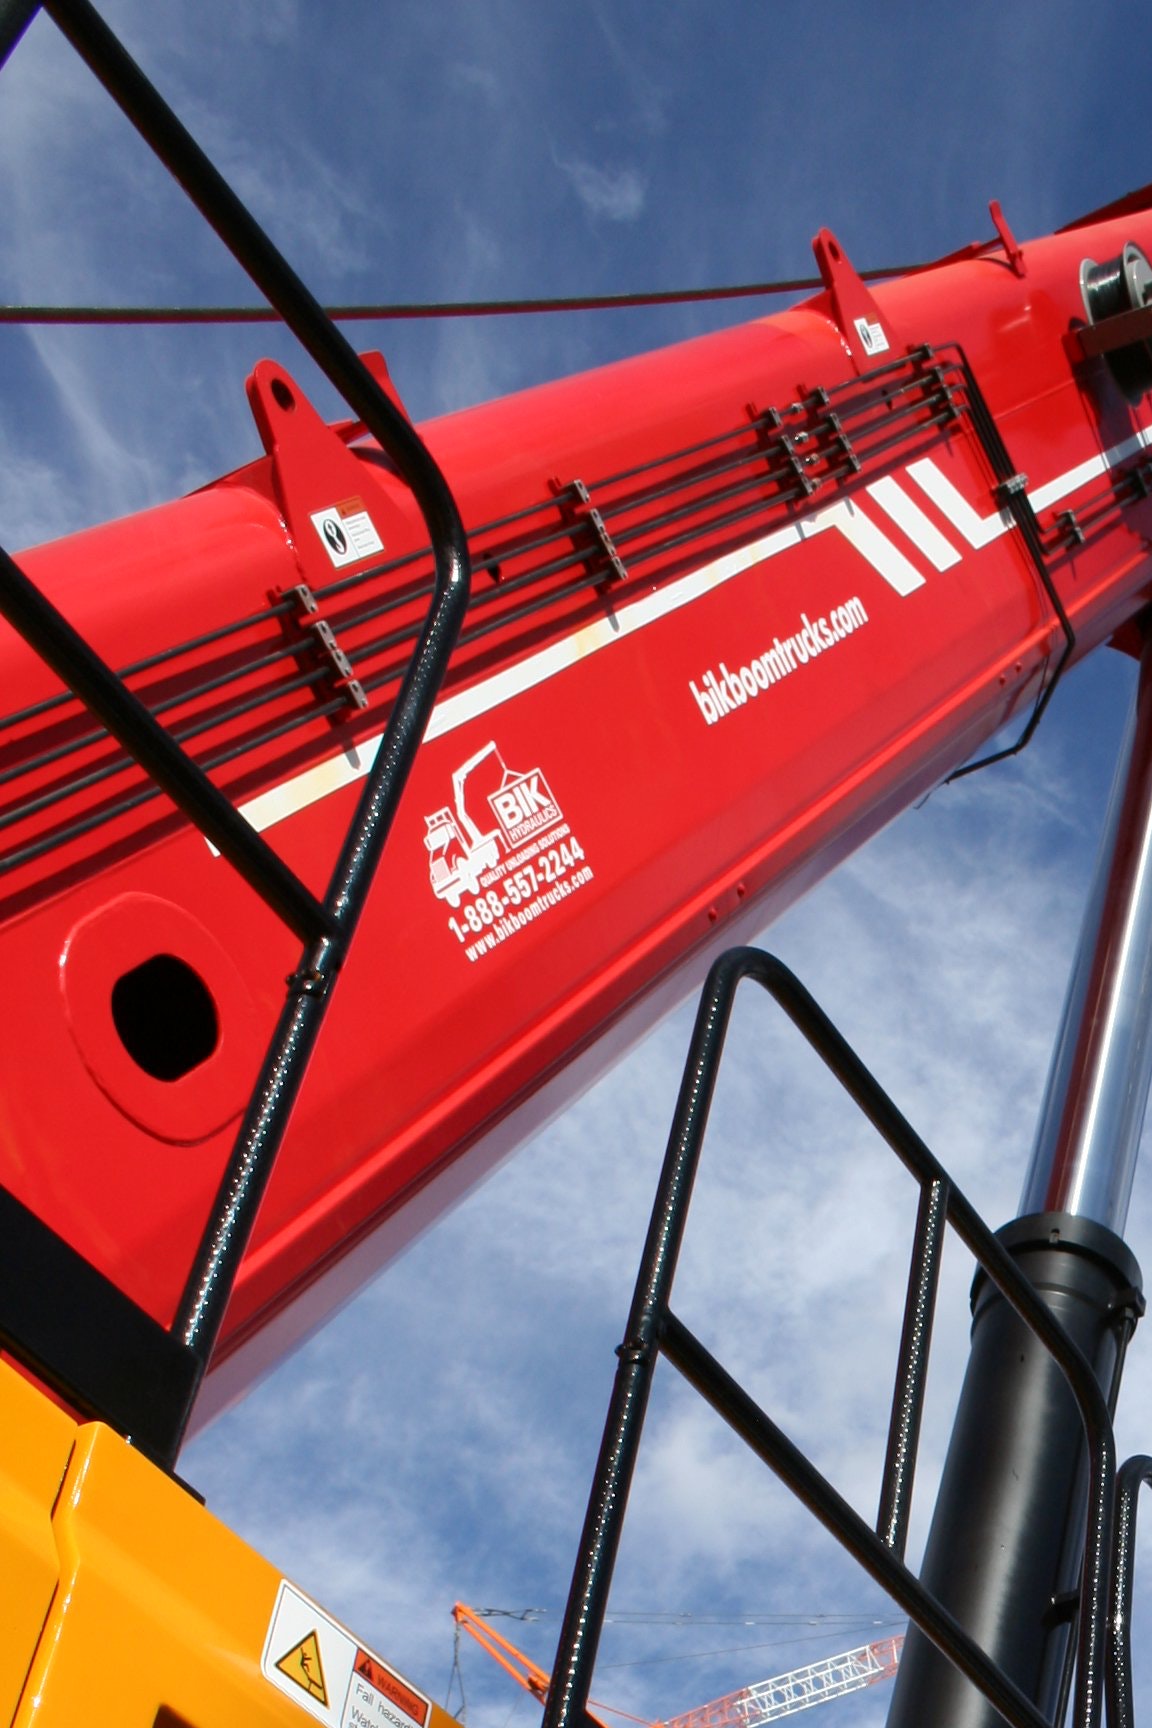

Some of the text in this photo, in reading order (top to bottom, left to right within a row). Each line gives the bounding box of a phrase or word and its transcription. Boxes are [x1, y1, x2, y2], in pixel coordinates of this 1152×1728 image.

[689, 596, 869, 726] bikboomtrucks.com
[493, 775, 551, 830] BIK
[508, 804, 558, 841] HYDRAULICS
[480, 863, 507, 888] QUALITY
[537, 823, 571, 850] SOLUTIONS
[448, 836, 585, 943] 1-888-557-2244
[465, 866, 595, 962] www.bikboomtrucks.com
[356, 1682, 375, 1706] Fall
[377, 1674, 419, 1716] WARNING
